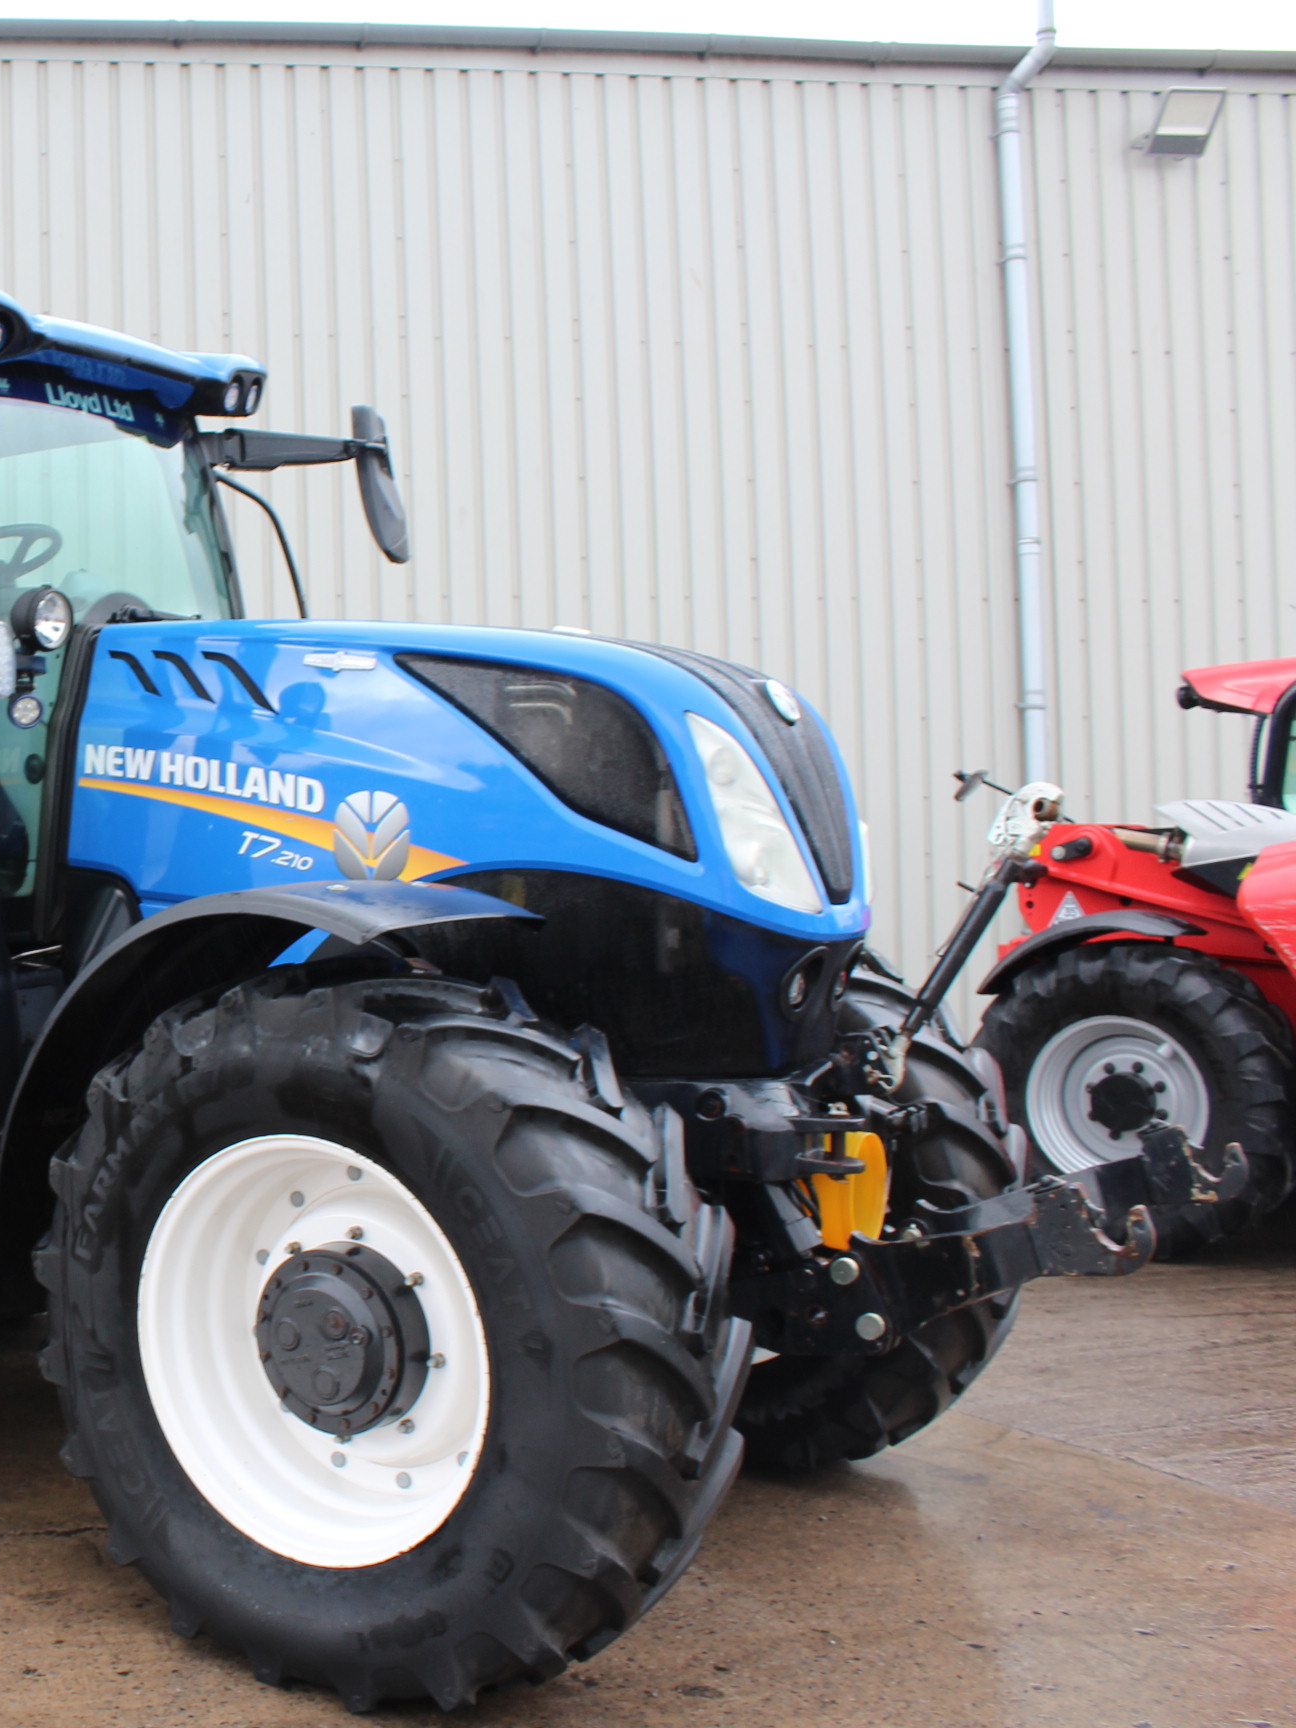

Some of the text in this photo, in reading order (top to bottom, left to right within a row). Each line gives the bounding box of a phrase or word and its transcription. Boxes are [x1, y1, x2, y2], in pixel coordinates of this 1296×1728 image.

[44, 382, 135, 422] Lloyd Ltd
[83, 743, 326, 814] NEW HOLLAND
[74, 1092, 175, 1262] FARMAX
[454, 1184, 533, 1312] CEAT
[86, 1388, 148, 1496] CEAT
